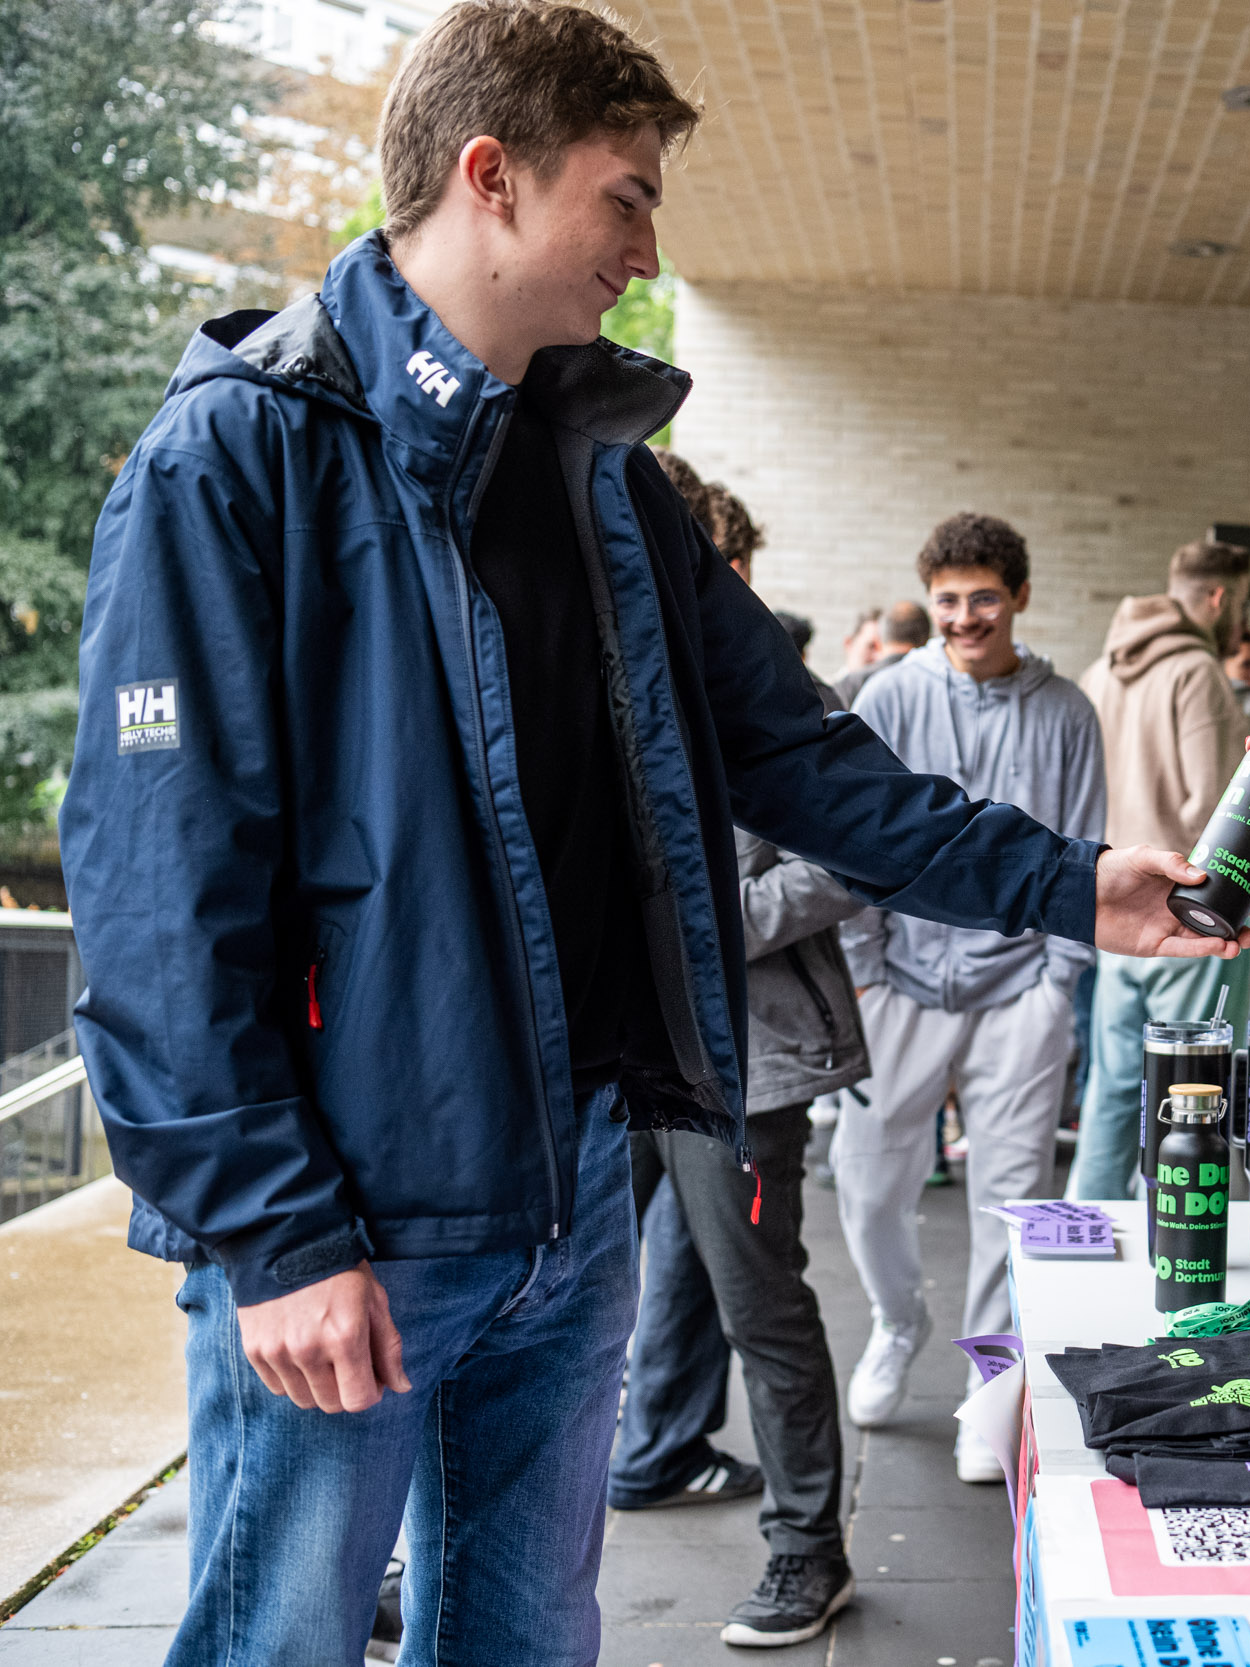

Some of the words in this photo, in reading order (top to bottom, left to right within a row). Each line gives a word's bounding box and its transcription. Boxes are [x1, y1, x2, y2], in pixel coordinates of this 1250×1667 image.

[405, 350, 461, 408] HH
[119, 685, 177, 728] HH
[1198, 1163, 1230, 1187] Du
[1169, 1221, 1189, 1230] Wahl.
[1189, 1222, 1210, 1231] Deine
[1175, 1258, 1211, 1270] Stadt
[1187, 1618, 1222, 1658] Ohne
